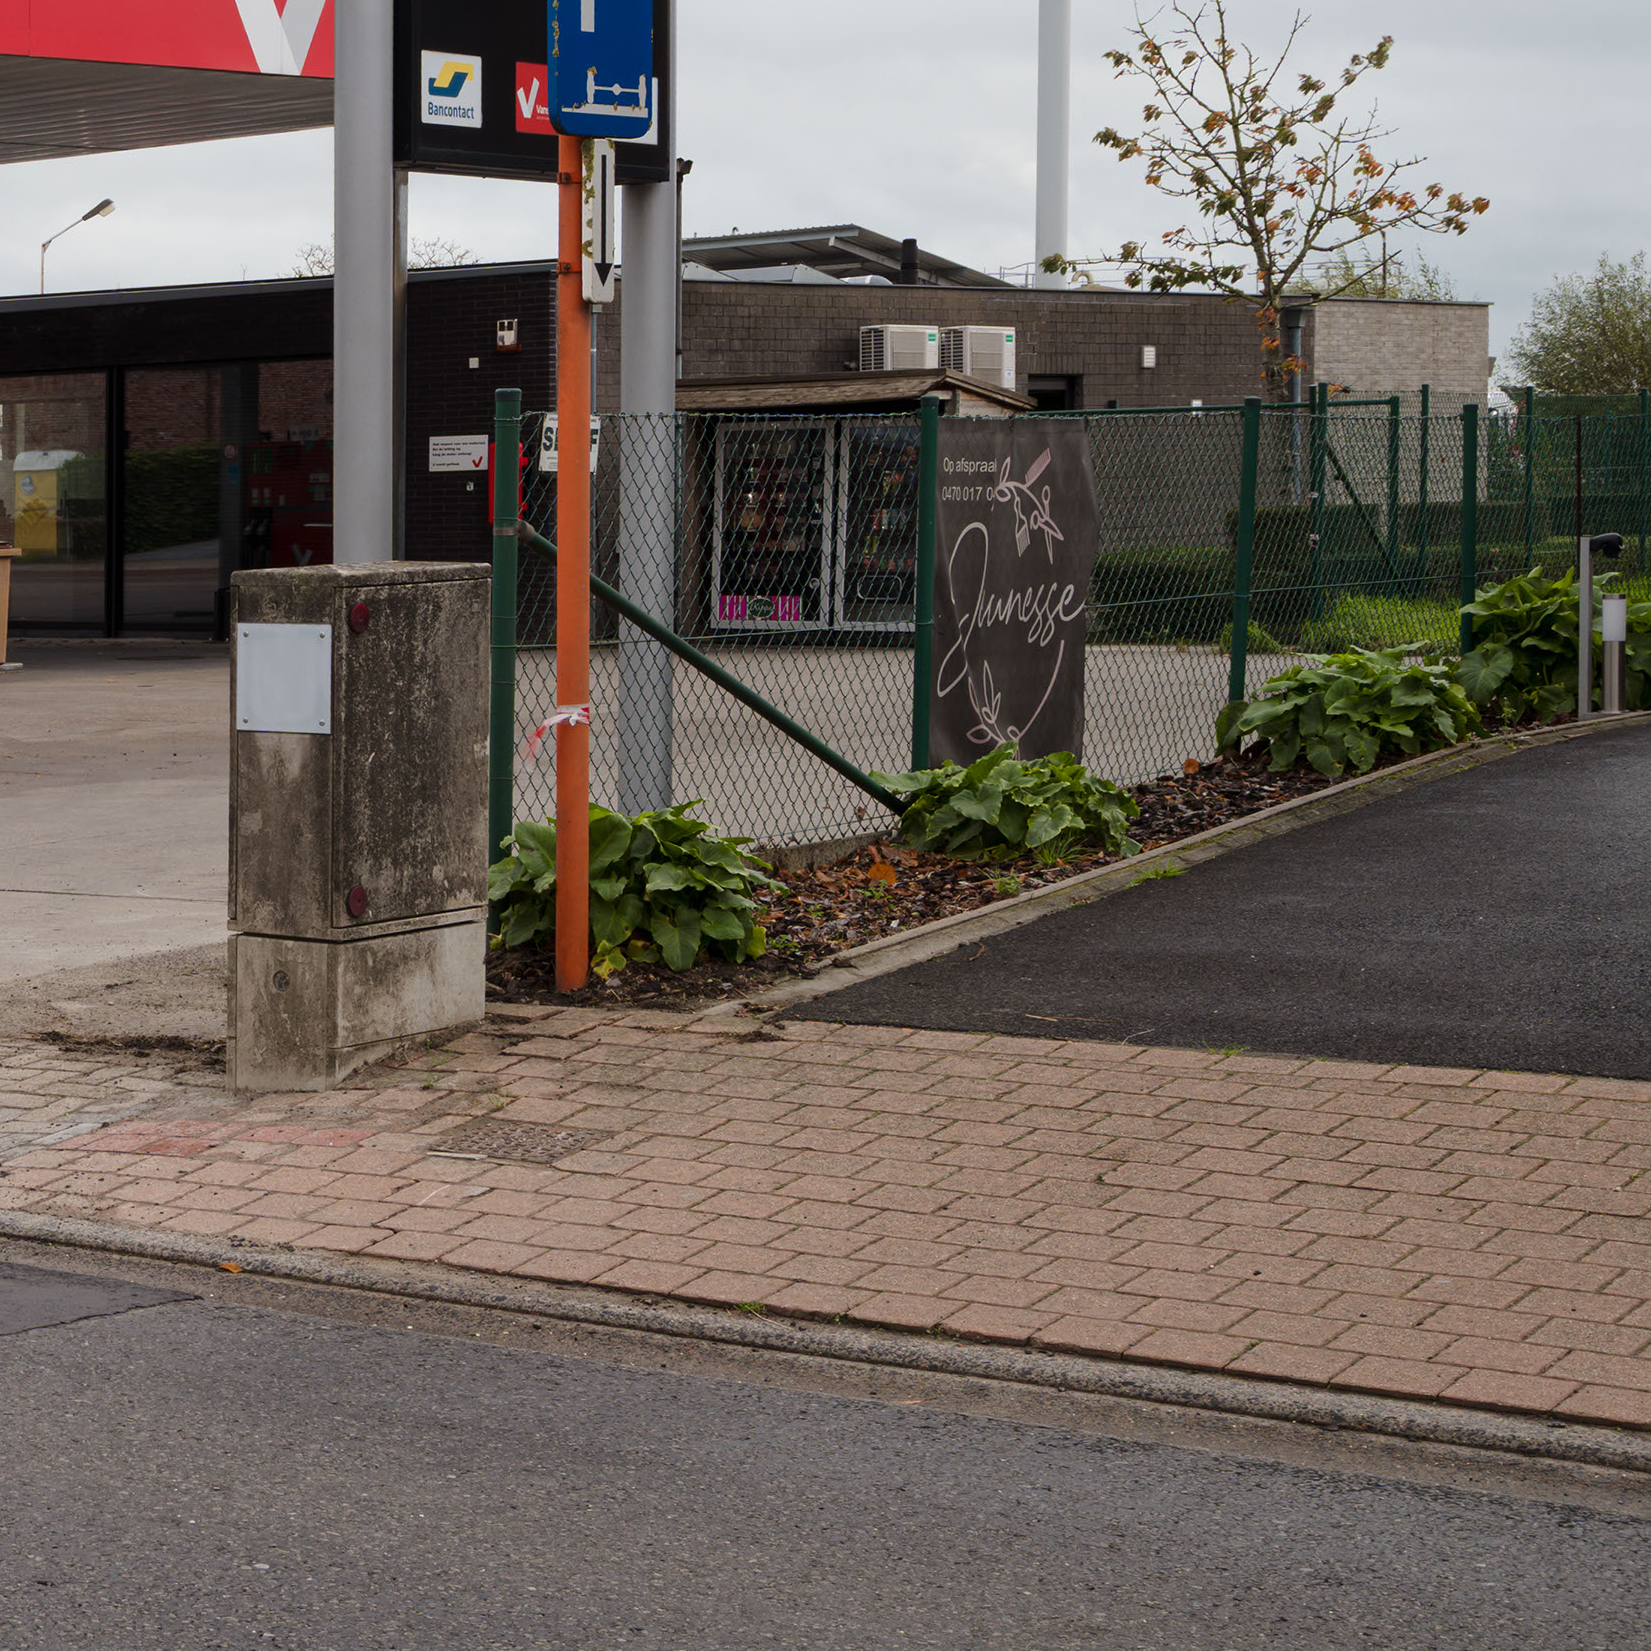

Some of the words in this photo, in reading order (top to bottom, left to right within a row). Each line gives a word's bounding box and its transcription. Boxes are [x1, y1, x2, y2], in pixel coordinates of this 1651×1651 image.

[427, 101, 475, 120] Bancontact
[543, 426, 599, 453] SF
[943, 456, 955, 476] Op
[941, 486, 962, 501] 0470
[963, 486, 983, 501] 017
[986, 486, 996, 501] 0
